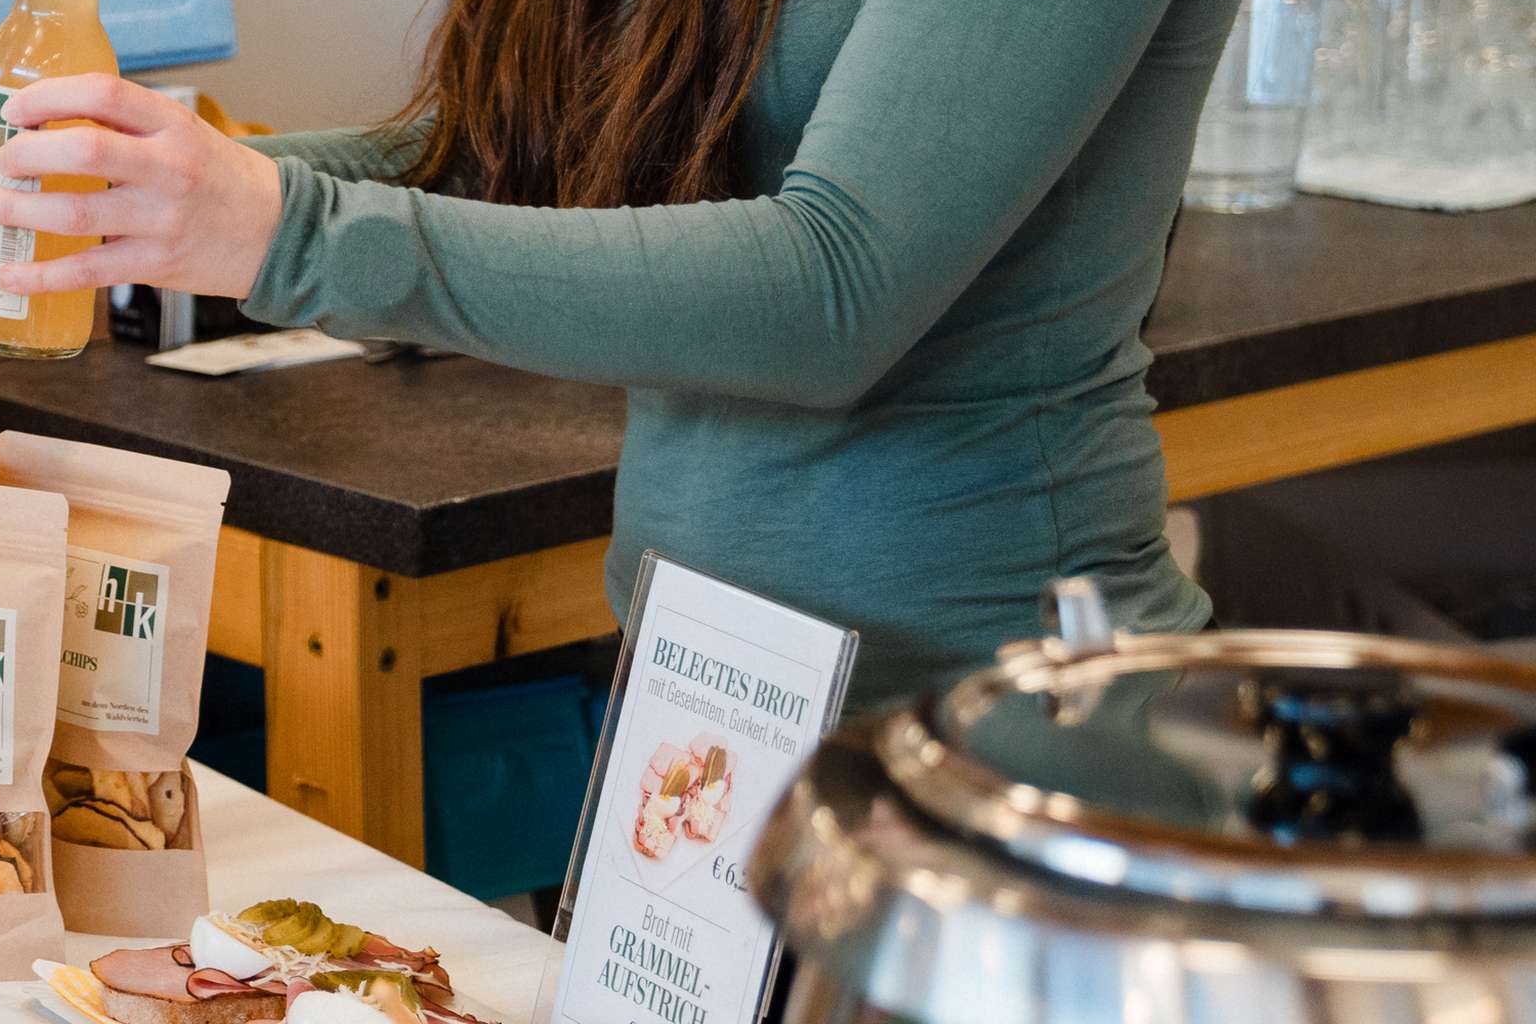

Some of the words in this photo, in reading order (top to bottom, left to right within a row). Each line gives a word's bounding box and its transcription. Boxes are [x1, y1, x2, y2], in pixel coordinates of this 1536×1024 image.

[647, 675, 667, 698] mit
[667, 680, 728, 730] Geselchtem,
[772, 723, 797, 757] Kren
[651, 635, 752, 702] BELEGTES
[752, 677, 810, 727] BROT
[712, 855, 725, 880] €
[609, 923, 711, 1000] GRAMMEL-
[642, 903, 671, 936] Brot
[670, 919, 695, 953] mit
[596, 957, 709, 1024] AUFSTRICH
